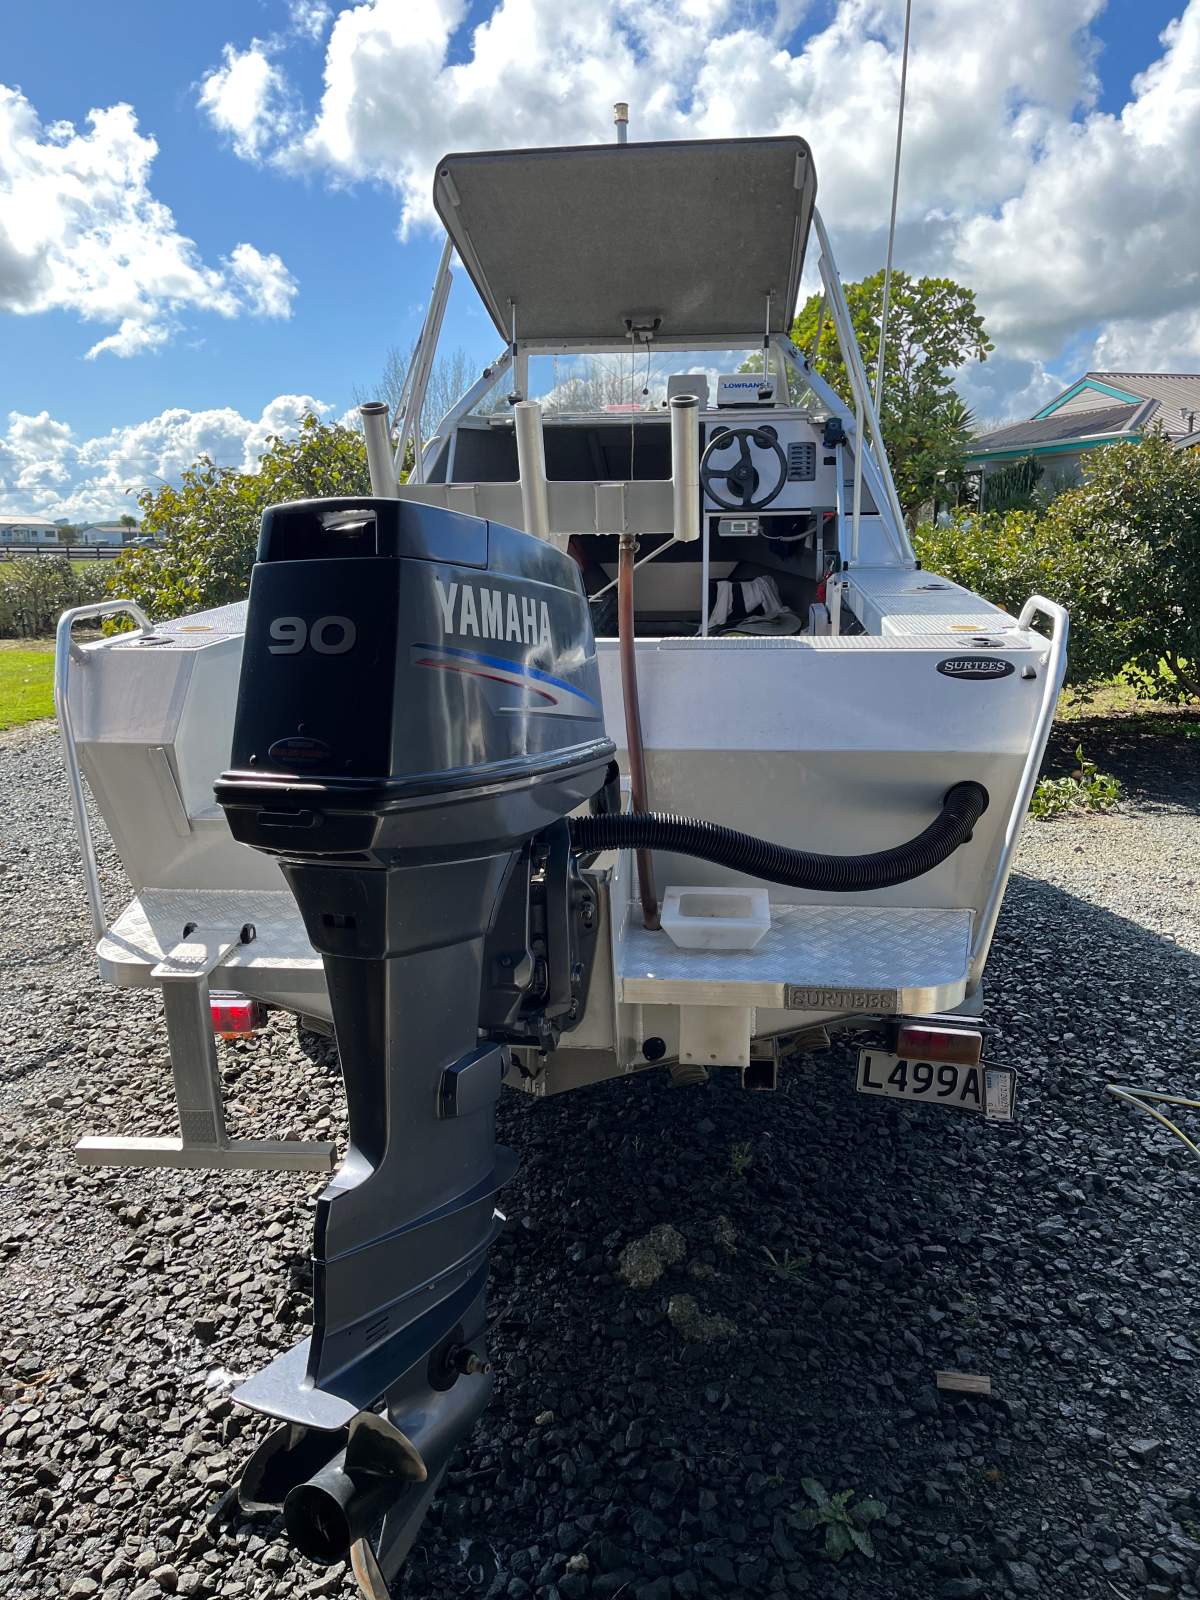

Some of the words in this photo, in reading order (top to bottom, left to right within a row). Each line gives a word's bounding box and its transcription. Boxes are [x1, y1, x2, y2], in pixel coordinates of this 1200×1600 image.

[434, 578, 552, 648] YAMAHA
[268, 616, 356, 654] 90
[944, 661, 1007, 672] SURTEES
[793, 990, 892, 1009] SURTEES
[863, 1056, 980, 1103] L499A
